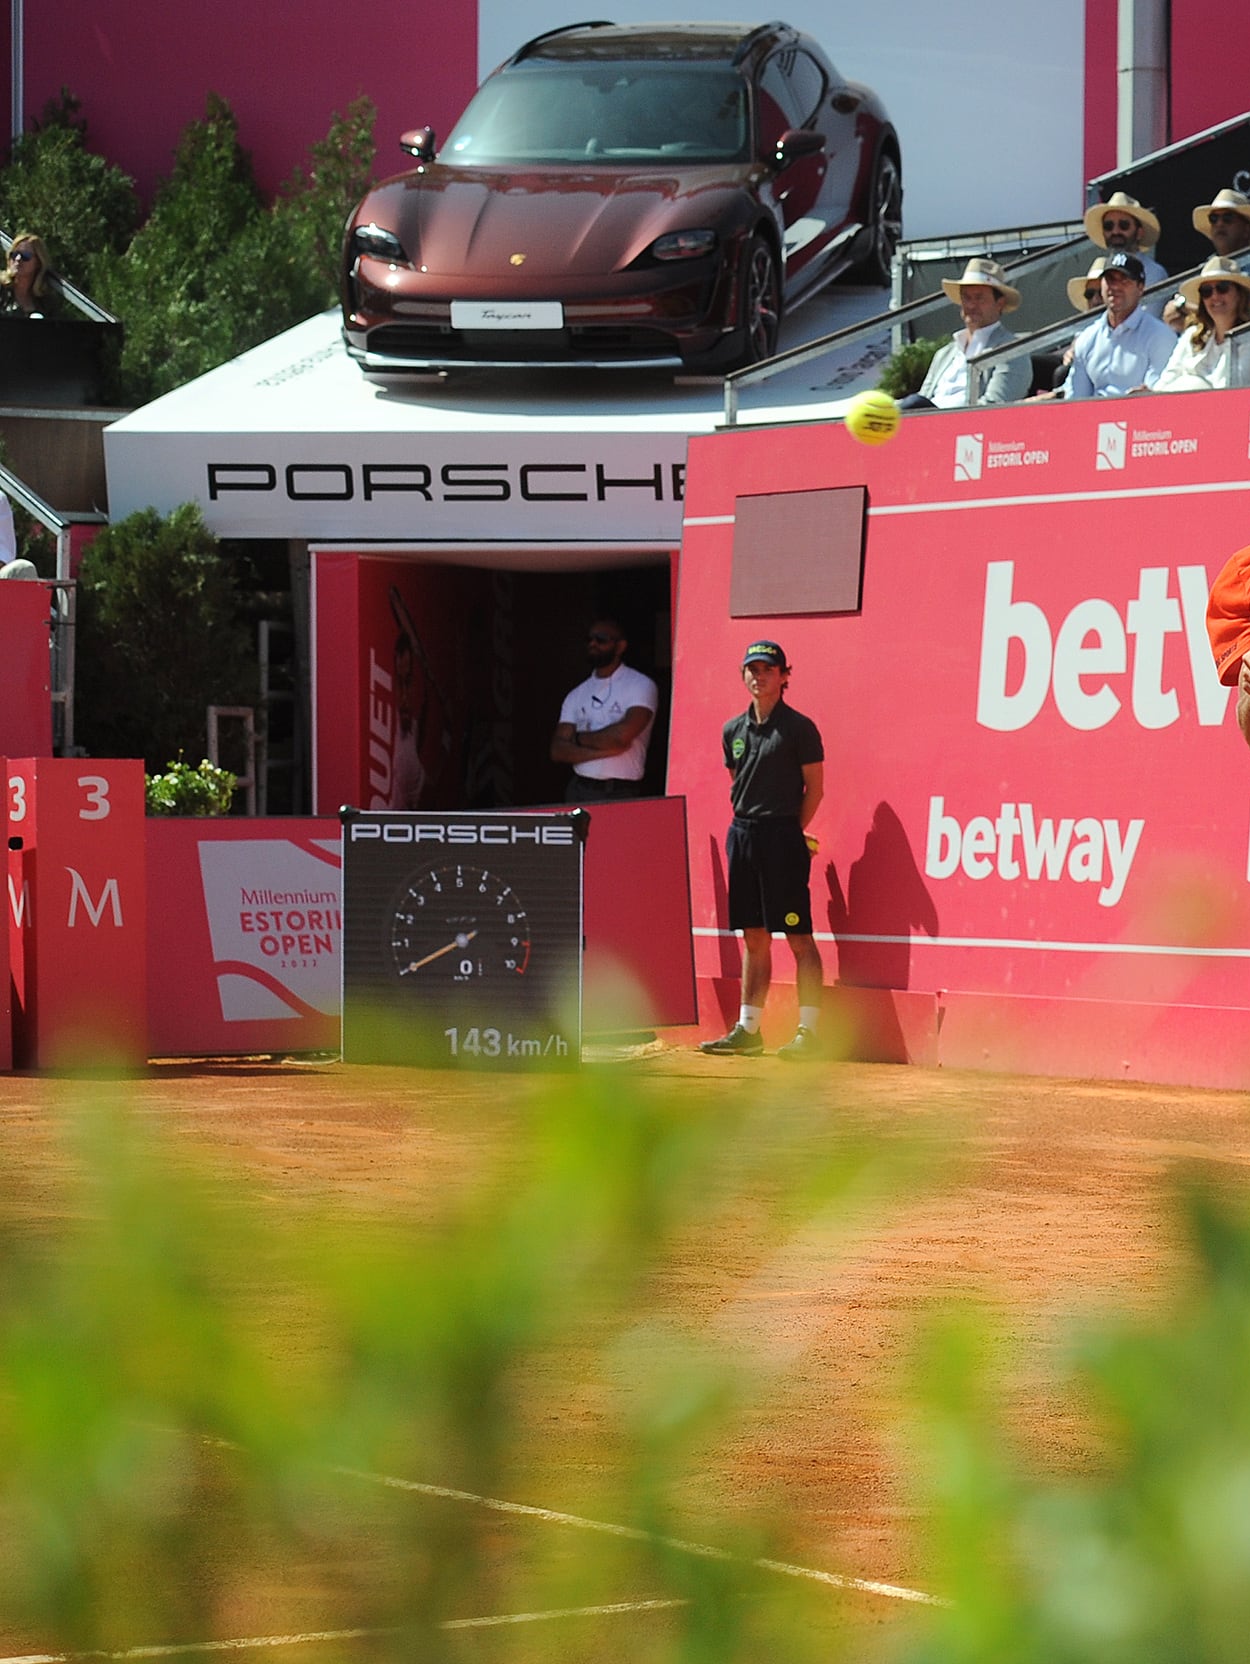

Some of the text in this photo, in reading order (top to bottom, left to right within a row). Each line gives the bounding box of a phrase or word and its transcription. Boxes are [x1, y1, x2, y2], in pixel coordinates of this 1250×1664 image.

[1131, 438, 1198, 457] ESTORIL OPEN
[987, 450, 1049, 468] ESTORIL OPEN
[207, 463, 686, 501] PORSCH
[8, 776, 26, 822] 3
[77, 776, 110, 820] 3
[351, 824, 573, 844] PORSCHE
[925, 796, 1145, 907] betway
[456, 878, 464, 888] 5
[64, 866, 123, 927] M
[241, 888, 337, 904] Millennium
[261, 934, 333, 956] OPEN
[460, 959, 473, 975] 0
[444, 1028, 568, 1057] 143 km/h
